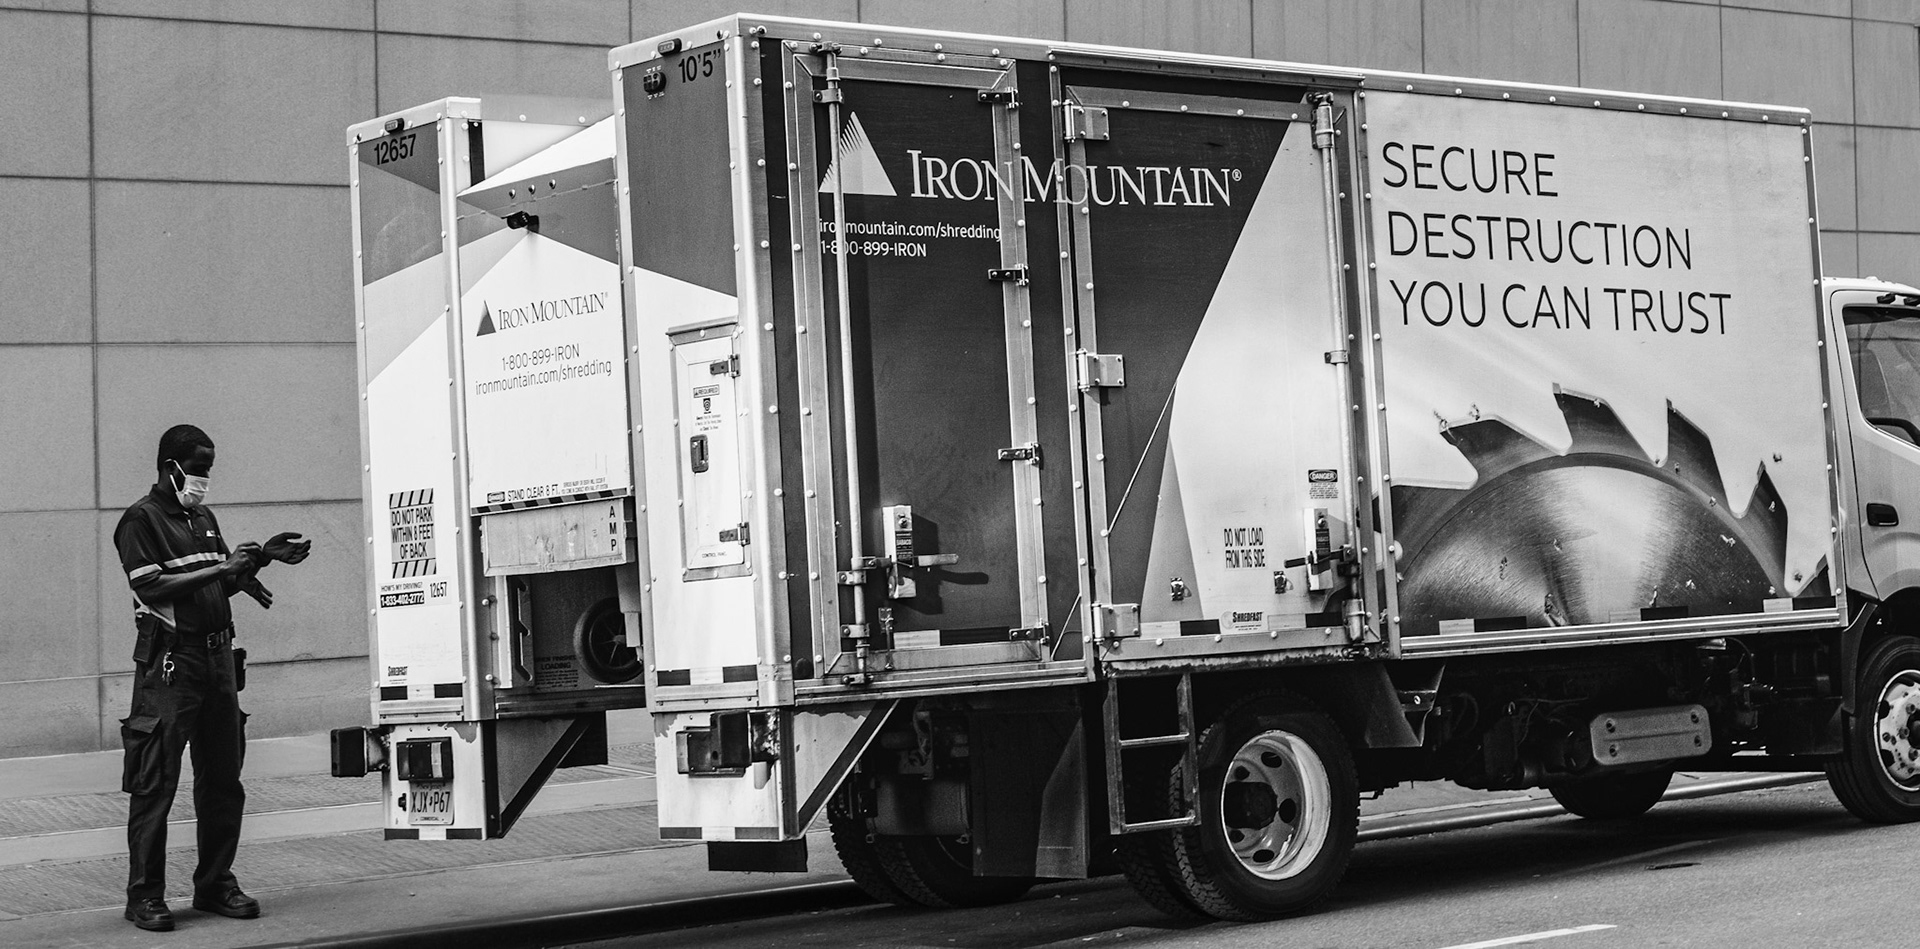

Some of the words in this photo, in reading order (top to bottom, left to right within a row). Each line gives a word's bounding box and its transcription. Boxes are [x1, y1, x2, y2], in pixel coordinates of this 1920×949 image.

[374, 134, 416, 165] 12657
[906, 149, 1013, 201] IRON
[1382, 141, 1558, 197] SECURE
[819, 218, 1001, 242] iromountain.com/shredding
[1387, 210, 1692, 270] DESTRUCTION
[1389, 279, 1487, 328] YOU
[1502, 283, 1591, 330] CAN
[1603, 287, 1732, 335] TRUST
[498, 306, 530, 331] IRON
[502, 343, 580, 371] 1-800-899-IRON
[475, 360, 612, 396] ironmountain.com/shredding
[1311, 472, 1335, 480] DANGER
[507, 488, 525, 501] STAND
[526, 485, 545, 499] CLEAR
[391, 510, 400, 526] DO
[402, 508, 414, 525] NOT
[416, 506, 433, 523] PARK
[392, 526, 413, 543] WITHIN
[413, 525, 418, 541] 8
[419, 523, 434, 540] FEET
[1224, 528, 1233, 547] DO
[1234, 527, 1246, 546] NOT
[1248, 527, 1264, 546] LOAD
[400, 543, 408, 559] OF
[410, 541, 427, 559] BACK
[1225, 549, 1240, 568] FROM
[1241, 549, 1252, 567] THIS
[1253, 548, 1266, 567] SIDE
[381, 584, 395, 593] HOW'S
[395, 583, 402, 591] MY
[403, 581, 423, 590] DRIVING?
[429, 581, 447, 598] 12657
[1232, 611, 1263, 623] SHREDFAST
[541, 661, 571, 670] LOADING
[411, 791, 428, 812] XJX
[433, 791, 451, 812] P67
